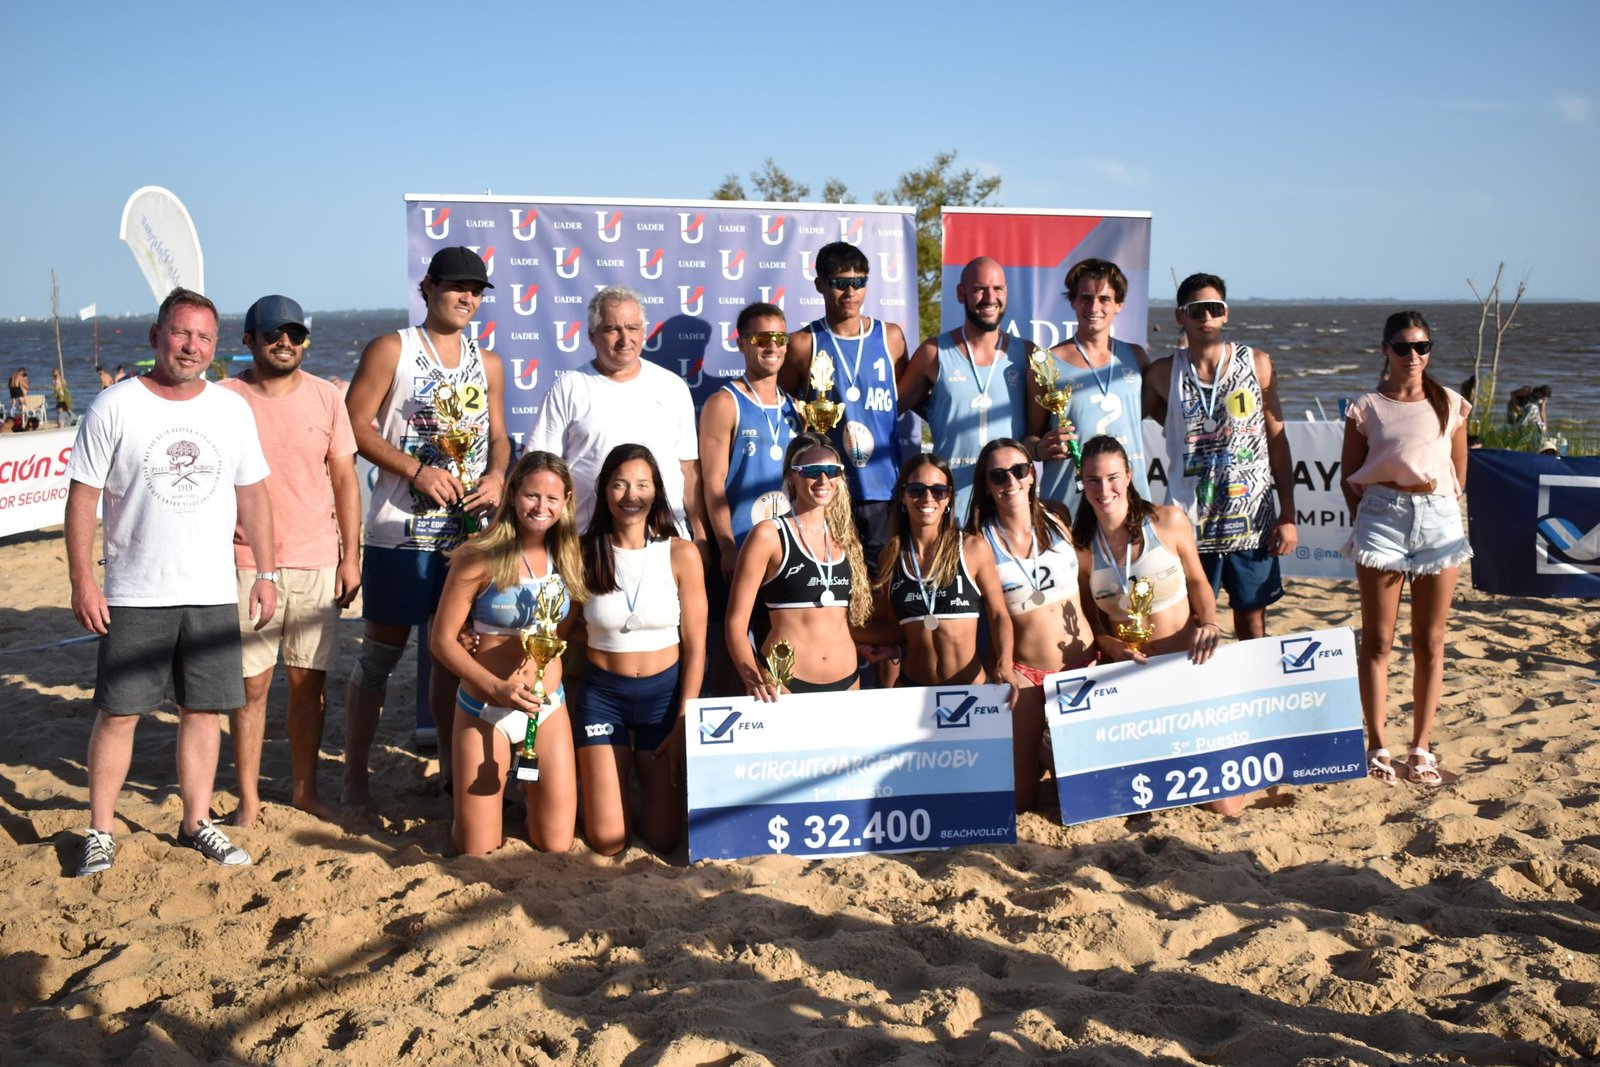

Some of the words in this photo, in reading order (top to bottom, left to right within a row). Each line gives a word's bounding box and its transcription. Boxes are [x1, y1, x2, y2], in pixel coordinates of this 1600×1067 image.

[422, 208, 450, 239] U
[466, 220, 495, 228] UADER
[509, 209, 538, 241] U
[554, 222, 582, 230] UADER
[595, 211, 623, 242] U
[637, 223, 664, 231] UADER
[678, 213, 704, 244] U
[759, 215, 785, 246] U
[510, 258, 539, 266] UADER
[553, 247, 581, 279] U
[637, 249, 665, 280] U
[719, 249, 746, 281] U
[510, 284, 539, 316] U
[555, 296, 582, 304] UADER
[678, 286, 704, 316] U
[719, 297, 745, 305] UADER
[880, 298, 906, 306] UADER
[553, 321, 581, 352] U
[678, 332, 706, 340] UADER
[511, 358, 540, 390] U
[873, 357, 886, 382] 1
[465, 386, 480, 410] 2
[865, 387, 893, 412] ARG
[1234, 392, 1246, 413] 1
[1297, 510, 1354, 527] MPI
[956, 575, 963, 594] 1
[1032, 566, 1055, 592] 2
[1318, 648, 1343, 659] FEVA
[1093, 686, 1118, 697] FEVA
[974, 705, 999, 715] FEVA
[1095, 691, 1327, 744] #CIRCUITOARGENTINOBV
[738, 721, 764, 731] FEVA
[1195, 730, 1249, 750] Puesto
[733, 749, 980, 781] #CIRCUITOARGENTINOBV
[1292, 763, 1360, 778] BEACHVOLLEY
[1131, 773, 1153, 808] $
[1165, 752, 1284, 802] 22.800
[835, 784, 893, 801] Puesto
[767, 814, 790, 854] $
[804, 808, 931, 849] 32.400
[940, 827, 1009, 839] BEACHVOLLEY
